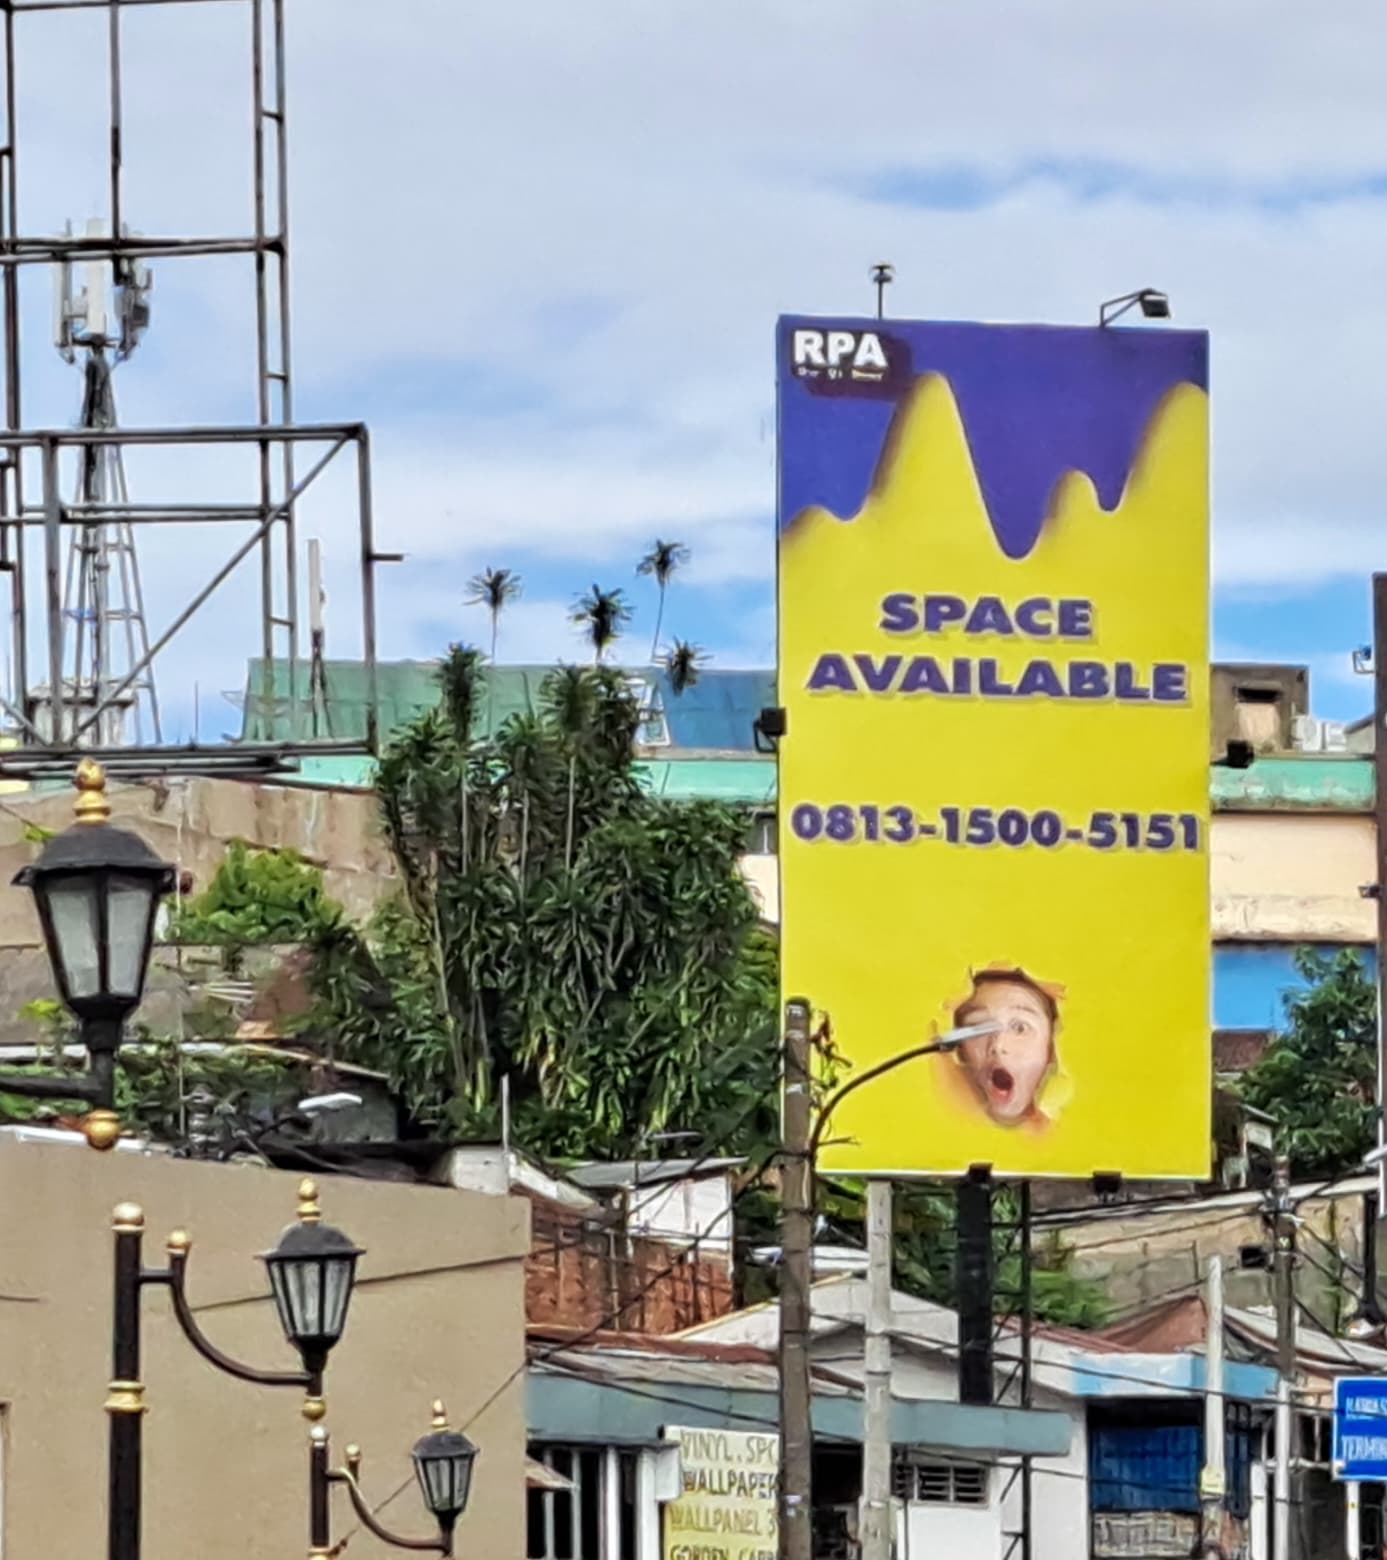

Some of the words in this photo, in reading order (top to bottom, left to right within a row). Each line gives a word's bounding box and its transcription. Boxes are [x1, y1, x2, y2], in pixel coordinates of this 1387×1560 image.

[794, 329, 889, 368] RPA
[879, 593, 1094, 639] SPACE
[807, 653, 1190, 702] AVAILABLE
[791, 803, 1200, 852] 0813-1500-5151
